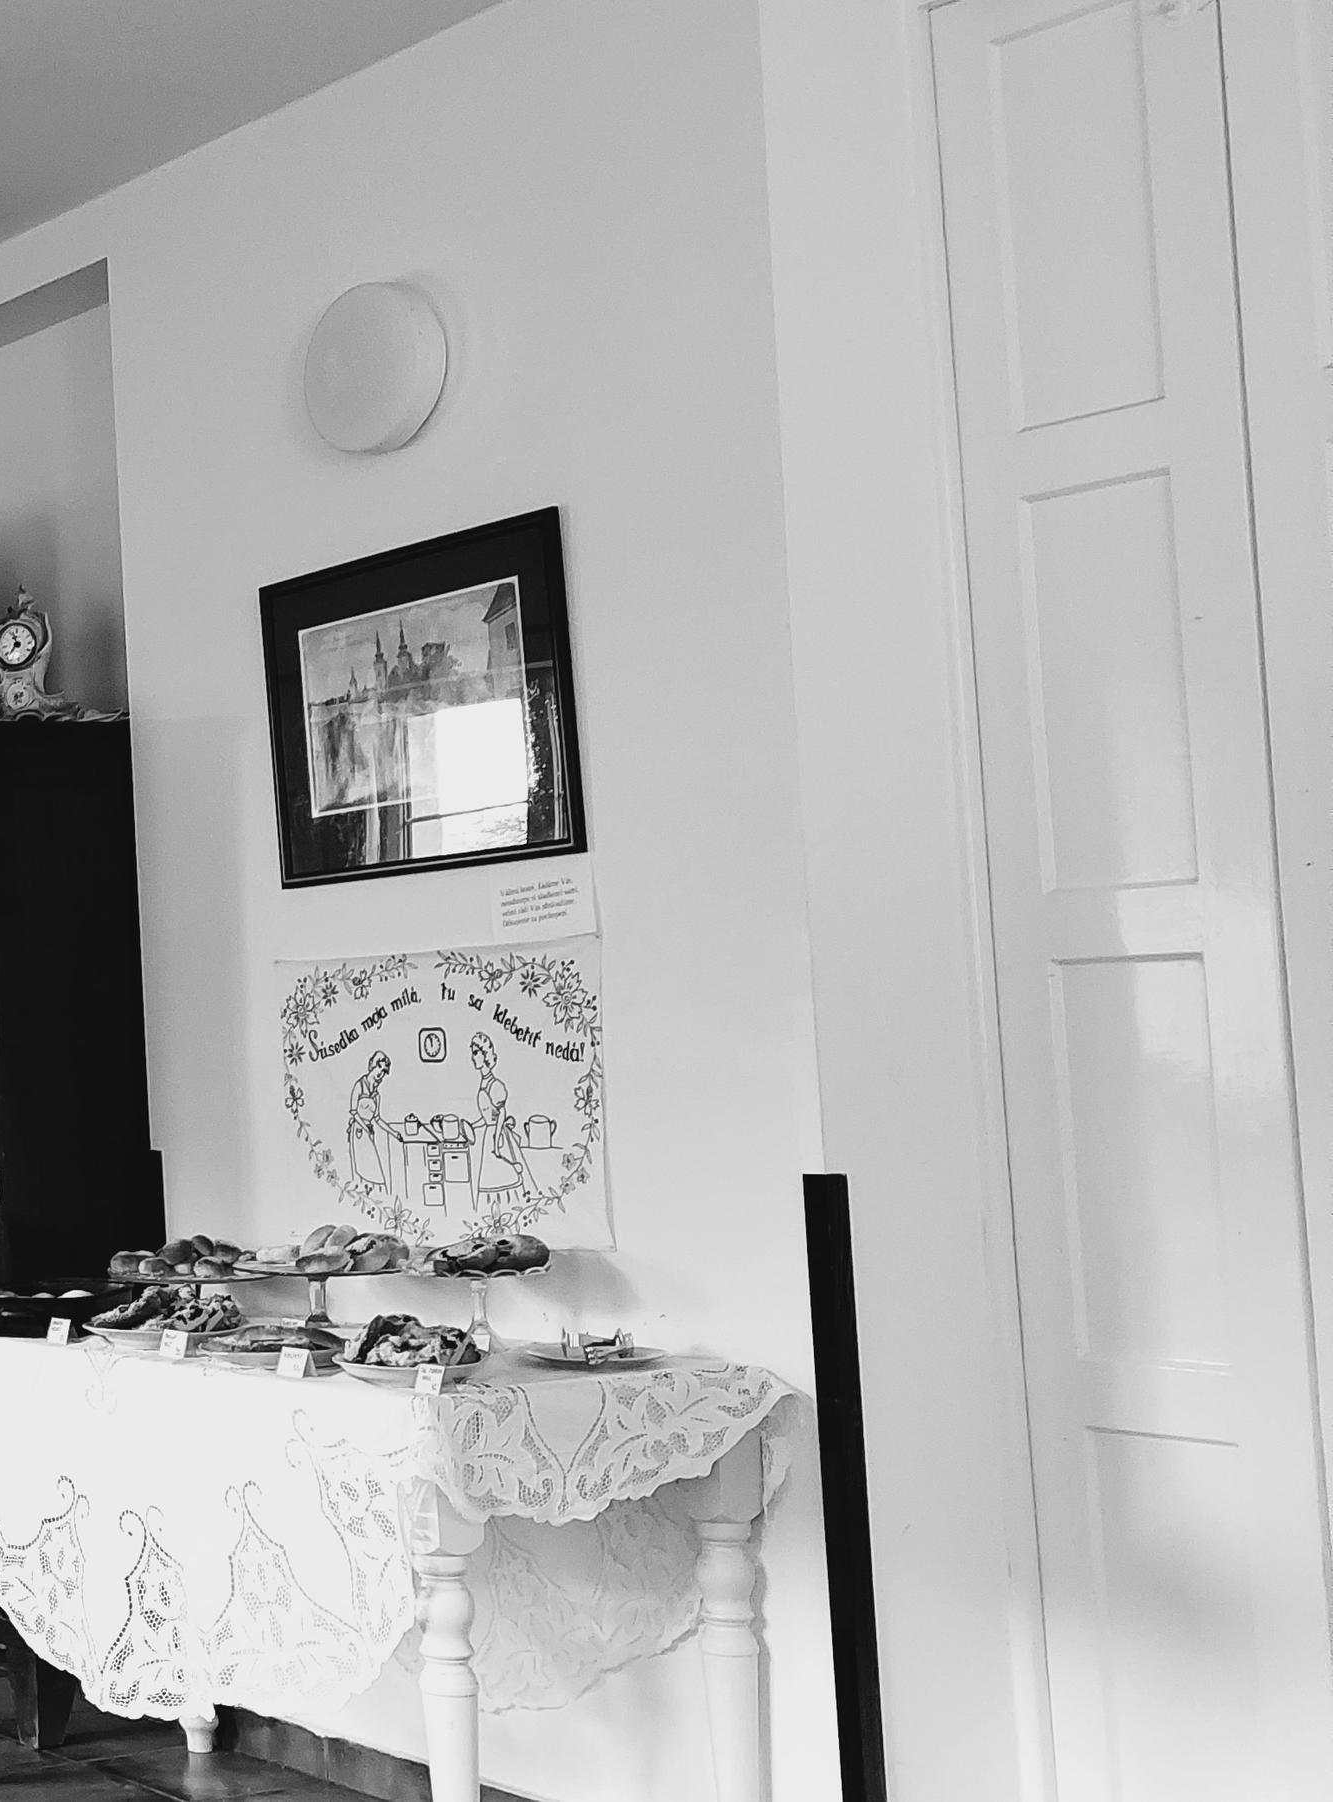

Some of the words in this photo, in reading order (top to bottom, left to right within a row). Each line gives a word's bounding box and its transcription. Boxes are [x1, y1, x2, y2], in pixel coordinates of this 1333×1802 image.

[308, 1029, 360, 1062] Súsedka
[361, 1006, 388, 1031] moja
[390, 986, 422, 1012] milá,
[440, 982, 456, 1001] tu
[468, 994, 484, 1012] sa
[545, 1041, 586, 1063] nedá!
